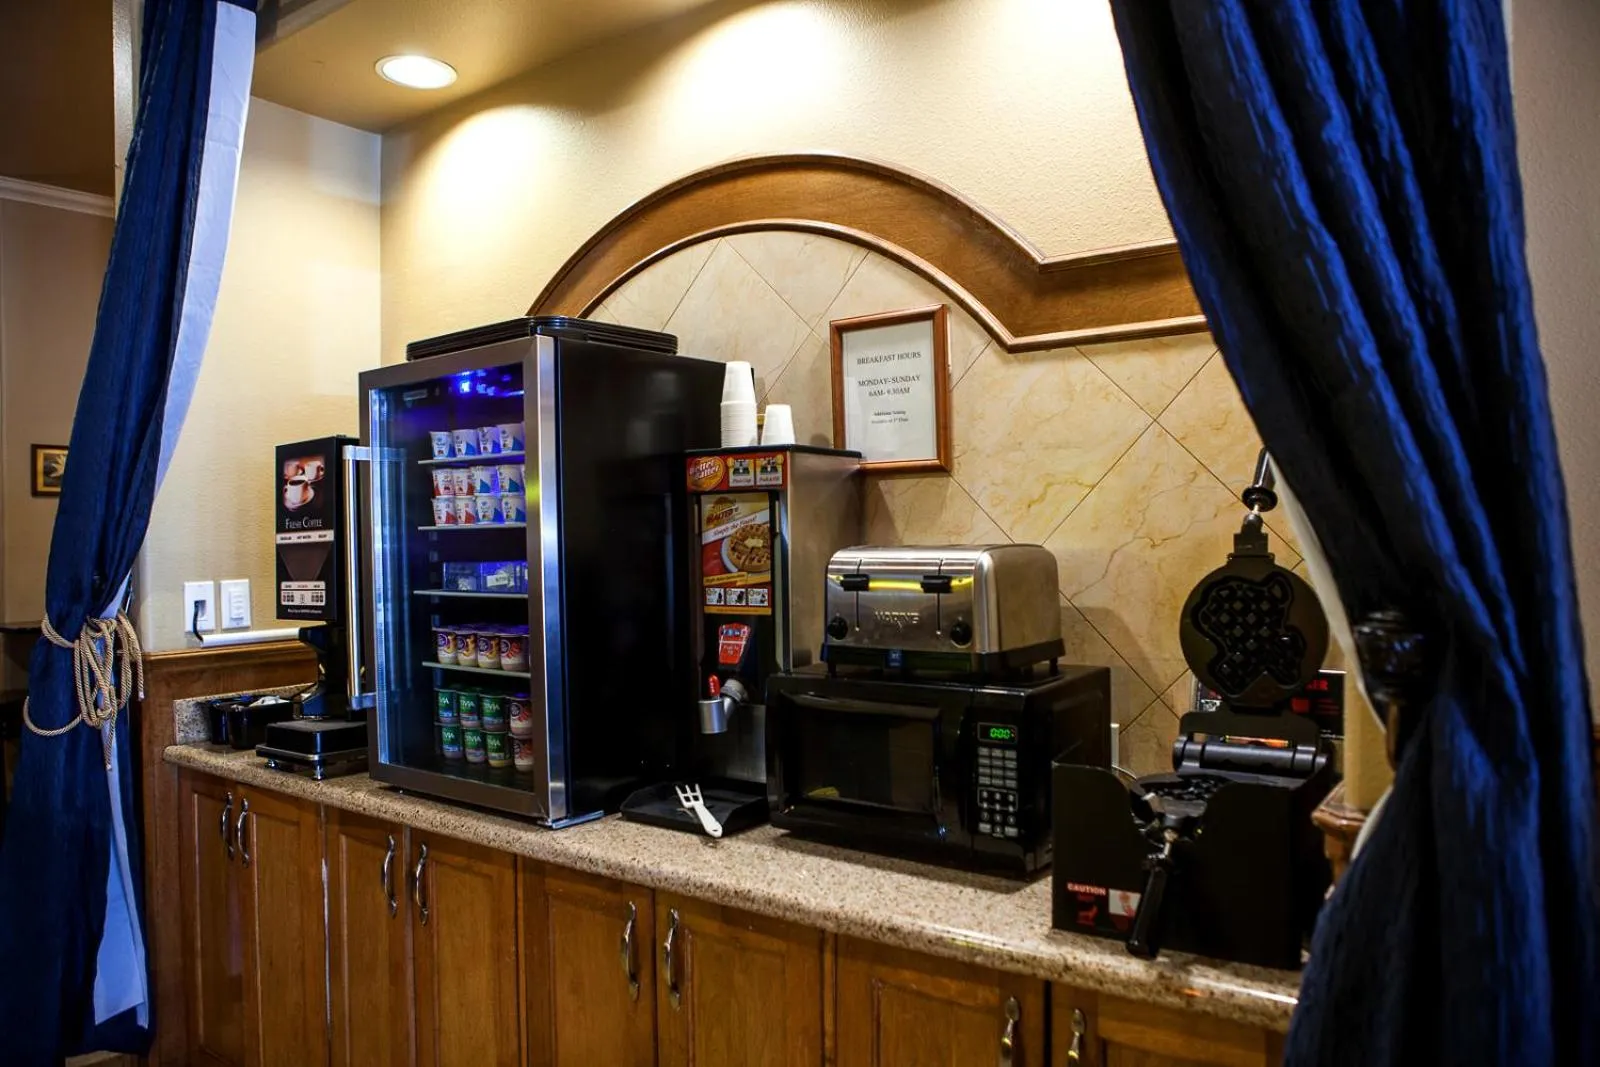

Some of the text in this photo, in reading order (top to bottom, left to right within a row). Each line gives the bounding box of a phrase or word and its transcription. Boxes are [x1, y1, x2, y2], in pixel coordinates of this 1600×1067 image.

[857, 351, 921, 365] BREAKFAST HOURS
[1066, 882, 1107, 897] CAUTION
